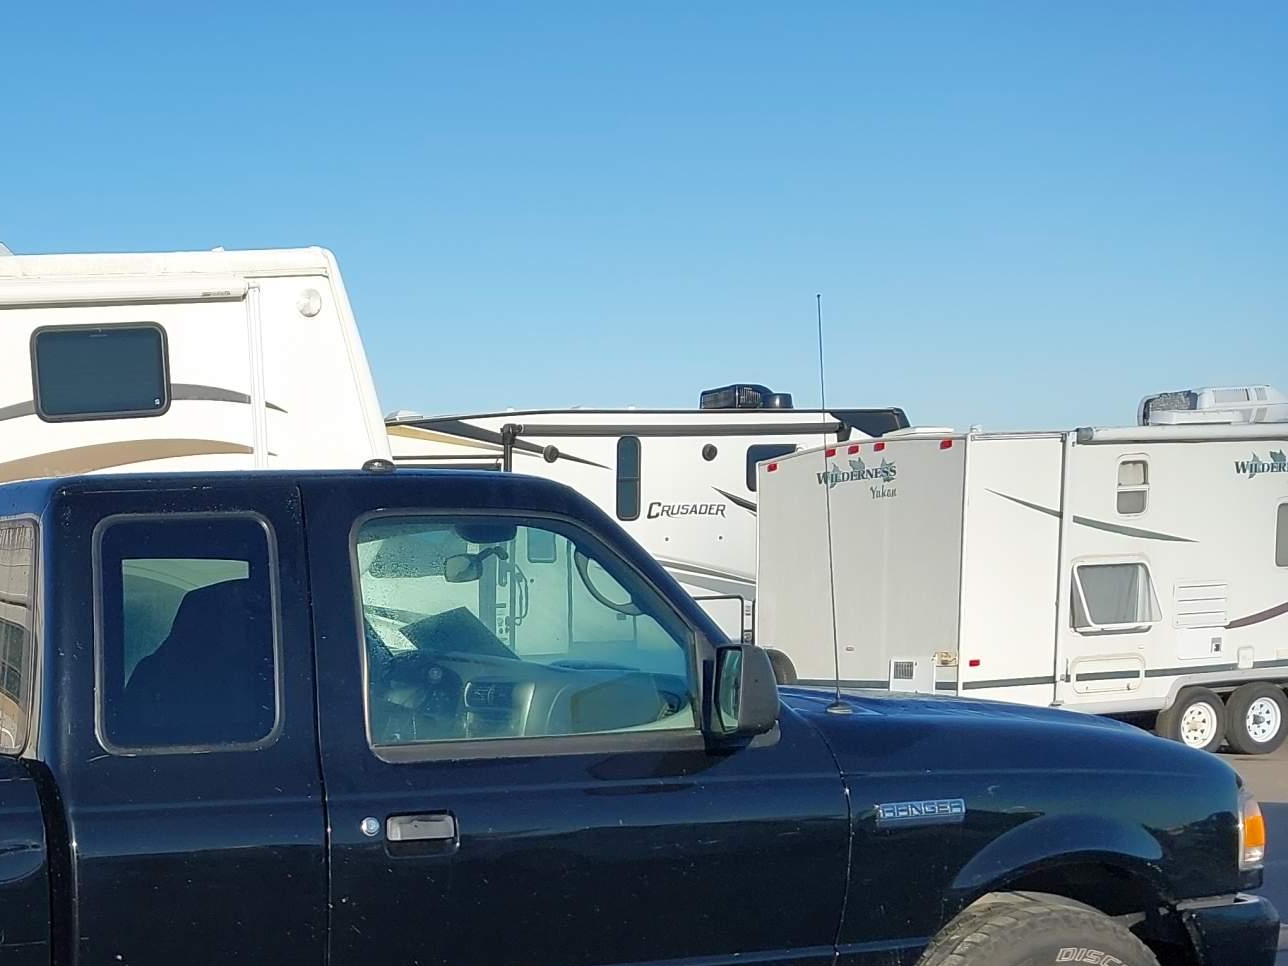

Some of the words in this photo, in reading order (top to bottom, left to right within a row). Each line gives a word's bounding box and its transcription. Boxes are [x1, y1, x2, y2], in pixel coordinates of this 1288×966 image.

[816, 465, 897, 485] WILDERNESS
[647, 502, 726, 519] CRUSADER
[879, 802, 962, 817] RANGER
